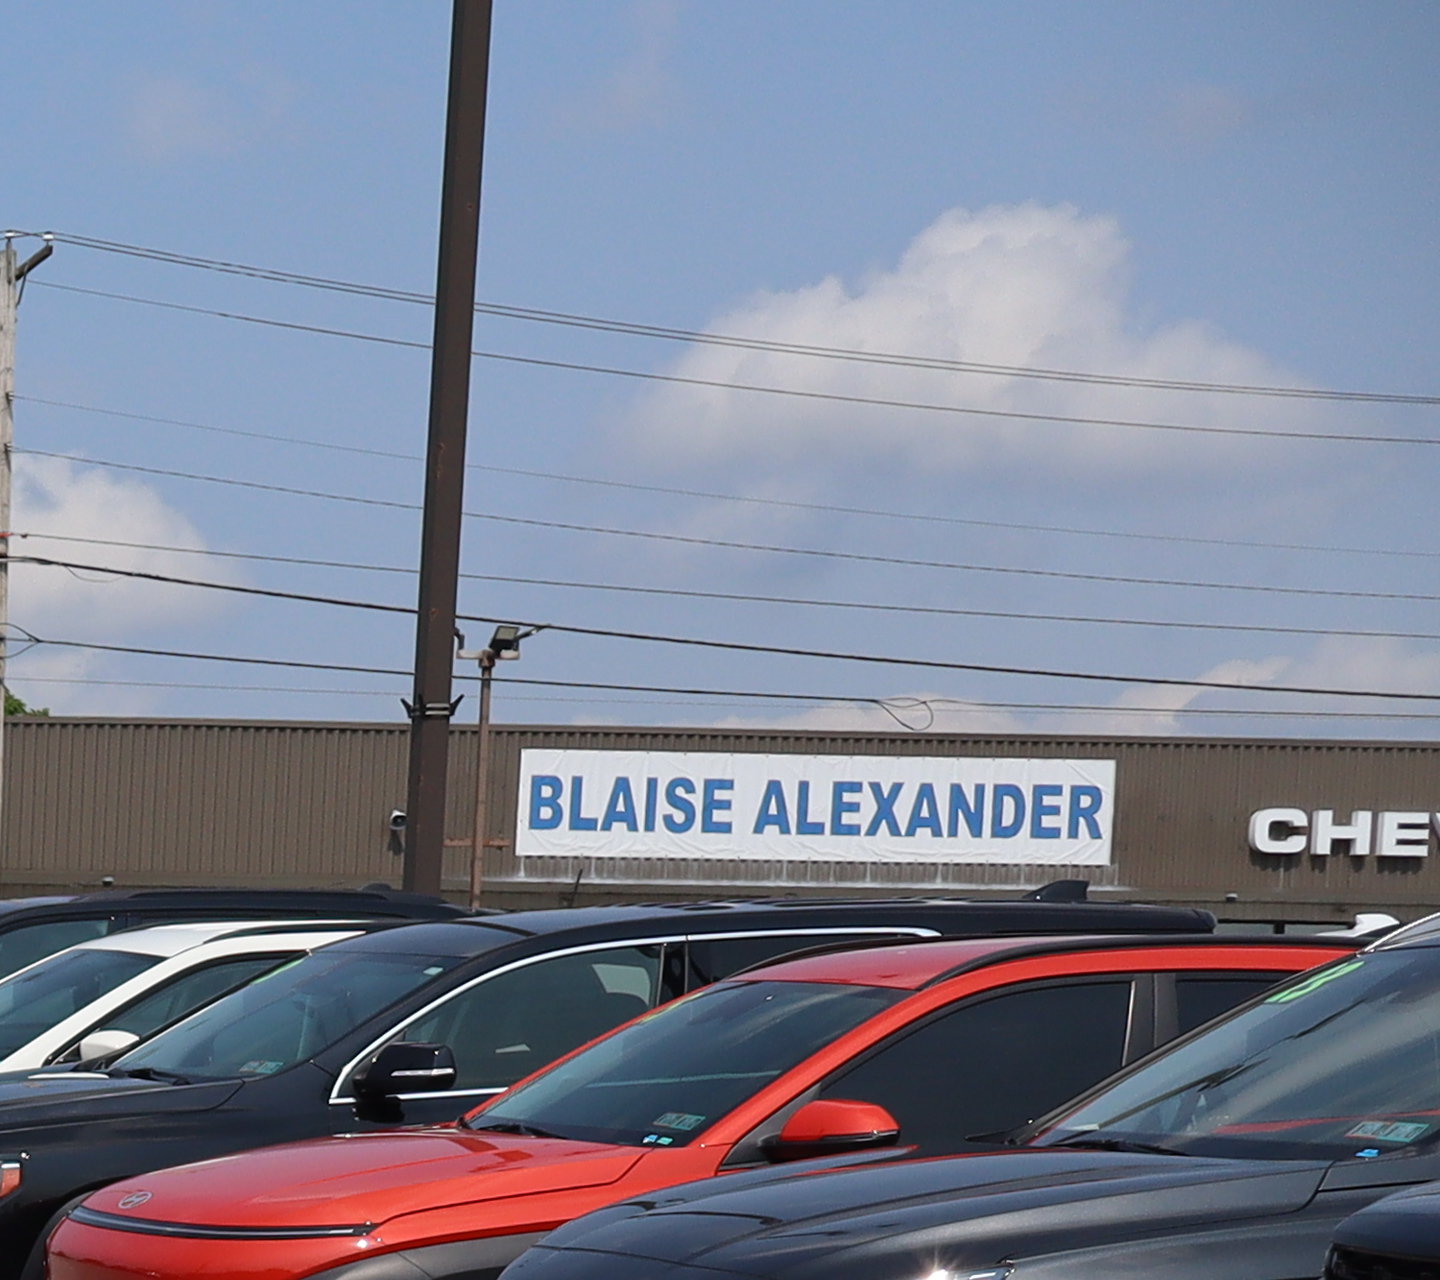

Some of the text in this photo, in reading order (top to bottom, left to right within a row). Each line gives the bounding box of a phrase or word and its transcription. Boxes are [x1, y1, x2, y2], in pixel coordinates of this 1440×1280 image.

[528, 774, 1104, 840] BLAISE ALEXANDER
[1248, 808, 1440, 857] CHE
